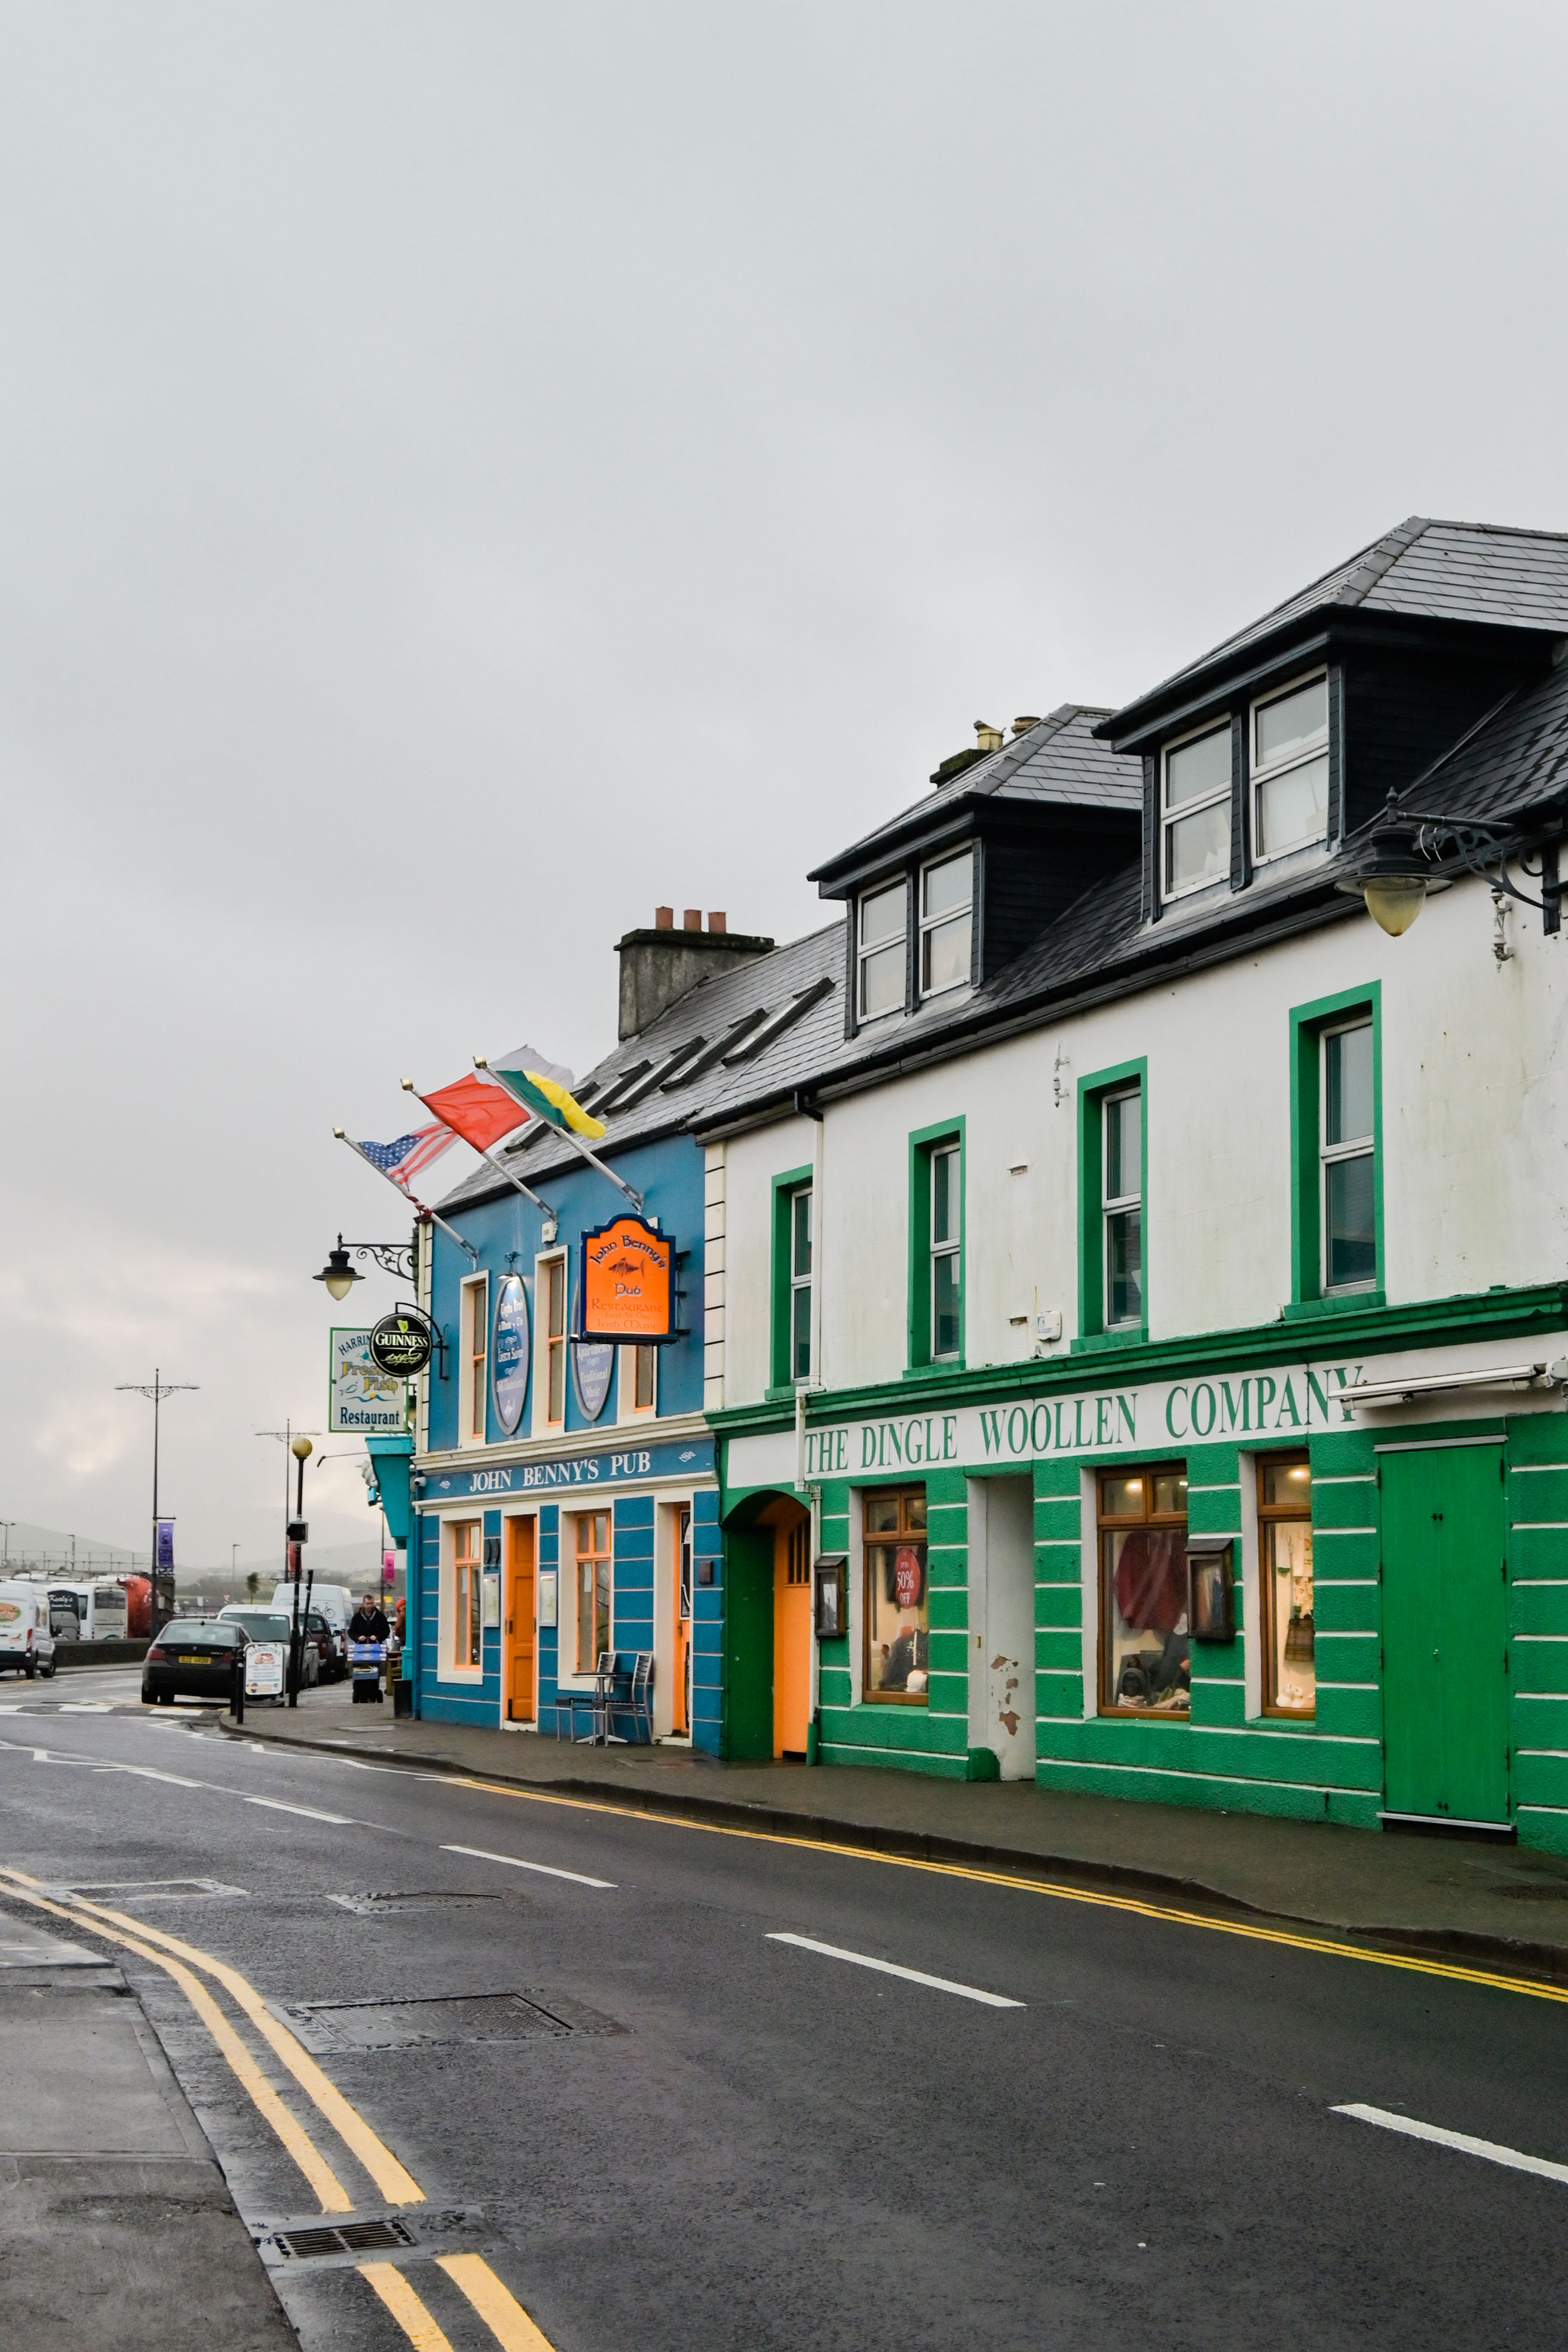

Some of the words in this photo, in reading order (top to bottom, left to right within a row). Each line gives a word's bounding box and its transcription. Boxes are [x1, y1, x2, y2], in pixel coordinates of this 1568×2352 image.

[589, 1242, 618, 1266] John
[621, 1235, 666, 1268] Benny's
[614, 1284, 641, 1298] Pub
[598, 1319, 620, 1328] Irish
[624, 1319, 658, 1329] Music
[375, 1333, 428, 1348] GUINNESS
[363, 1377, 398, 1395] Fish
[341, 1407, 399, 1425] Restaurant
[806, 1429, 849, 1474] THE
[860, 1416, 957, 1468] DINGLE
[979, 1393, 1138, 1456] WOOLLEN
[1166, 1365, 1364, 1438] COMPANY
[470, 1469, 512, 1492] JOHN
[522, 1459, 599, 1487] BENNY'S
[610, 1451, 651, 1476] PUB
[898, 1570, 914, 1591] 50%
[900, 1592, 910, 1604] OFF
